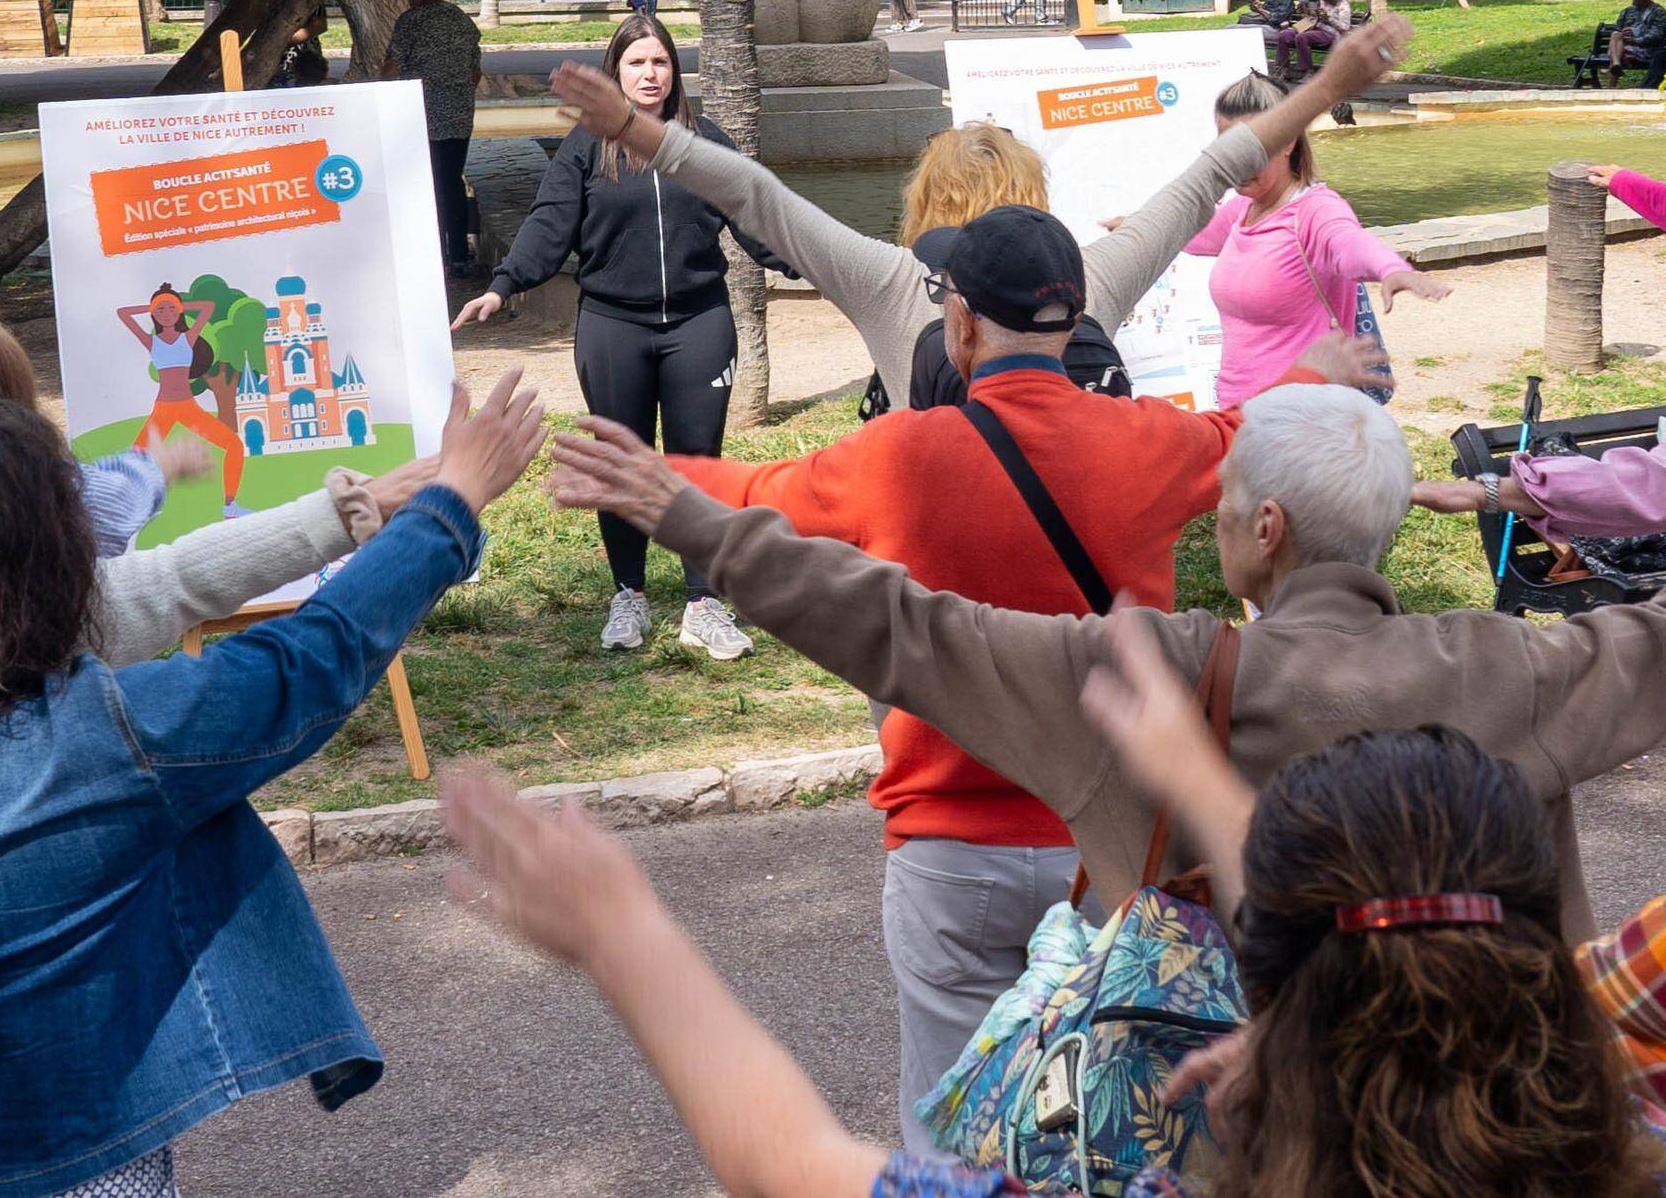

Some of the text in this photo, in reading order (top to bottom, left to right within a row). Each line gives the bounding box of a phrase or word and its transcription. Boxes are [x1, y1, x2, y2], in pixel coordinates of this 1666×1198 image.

[158, 115, 200, 127] VOTRE
[202, 110, 241, 124] SANTÉ
[244, 111, 258, 122] ET
[261, 106, 335, 120] DÉCOUVREZ
[1050, 96, 1155, 123] NICE CENTRE
[119, 134, 135, 145] LA
[137, 132, 170, 144] VILLE
[173, 131, 190, 142] DE
[192, 128, 221, 141] NICE
[224, 123, 298, 138] AUTREMENT
[153, 173, 203, 190] BOUCLE
[322, 166, 355, 190] #3
[123, 176, 311, 225] NICE CENTRE
[194, 220, 236, 234] patrimoine
[237, 211, 285, 226] architectural
